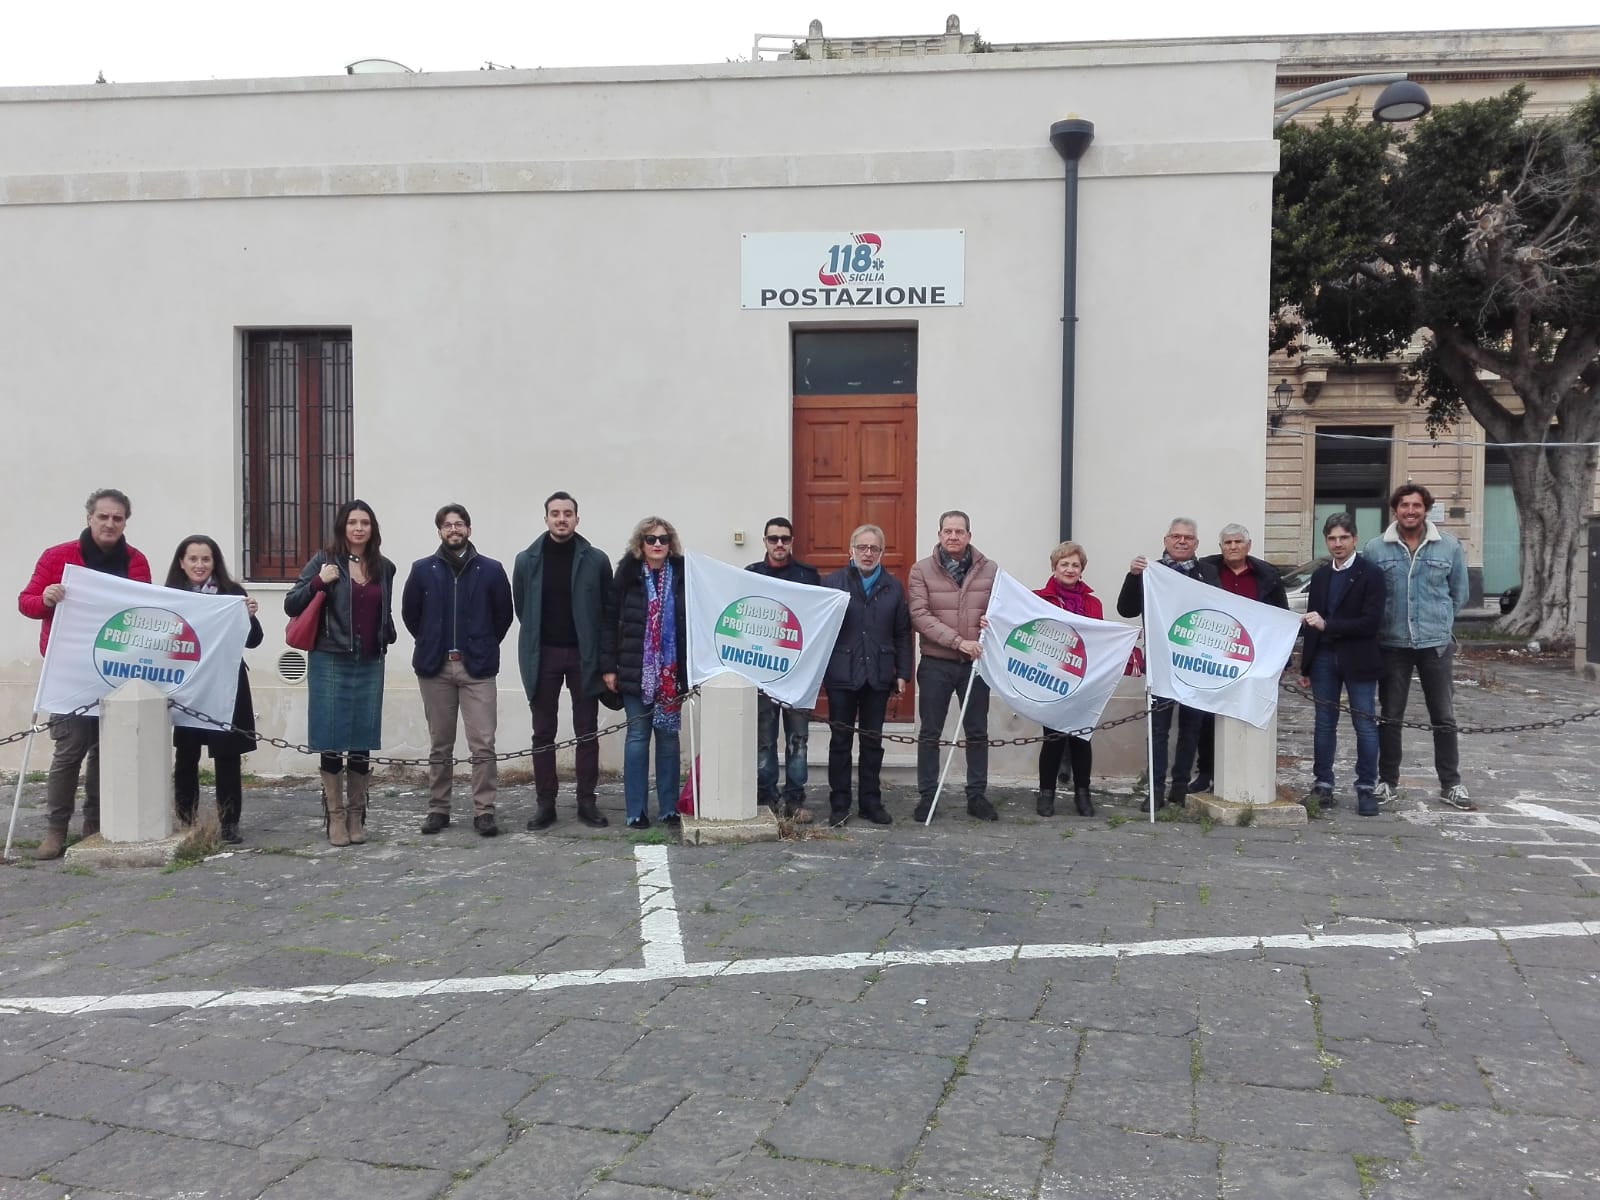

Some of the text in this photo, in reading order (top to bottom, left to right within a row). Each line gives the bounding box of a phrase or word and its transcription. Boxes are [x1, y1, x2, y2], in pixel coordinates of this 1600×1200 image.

[828, 244, 871, 272] 118
[849, 273, 885, 282] SICILIA
[761, 287, 946, 306] POSTAZIONE
[123, 612, 184, 635] SIRACUSA
[736, 602, 789, 623] SIRACUSA
[722, 616, 798, 642] PROTAGONISTA
[1032, 621, 1079, 649] SIRACUSA
[1189, 613, 1241, 639] SIRACUSA
[104, 628, 195, 653] PROTAGONISTA
[1014, 629, 1083, 669] PROTAGONISTA
[1173, 624, 1250, 656] PROTAGONISTA
[721, 644, 789, 673] VINCIULLO
[1172, 651, 1239, 679] VINCIULLO
[102, 659, 185, 685] VINCIULLO
[1007, 657, 1069, 696] VINCIULLO
